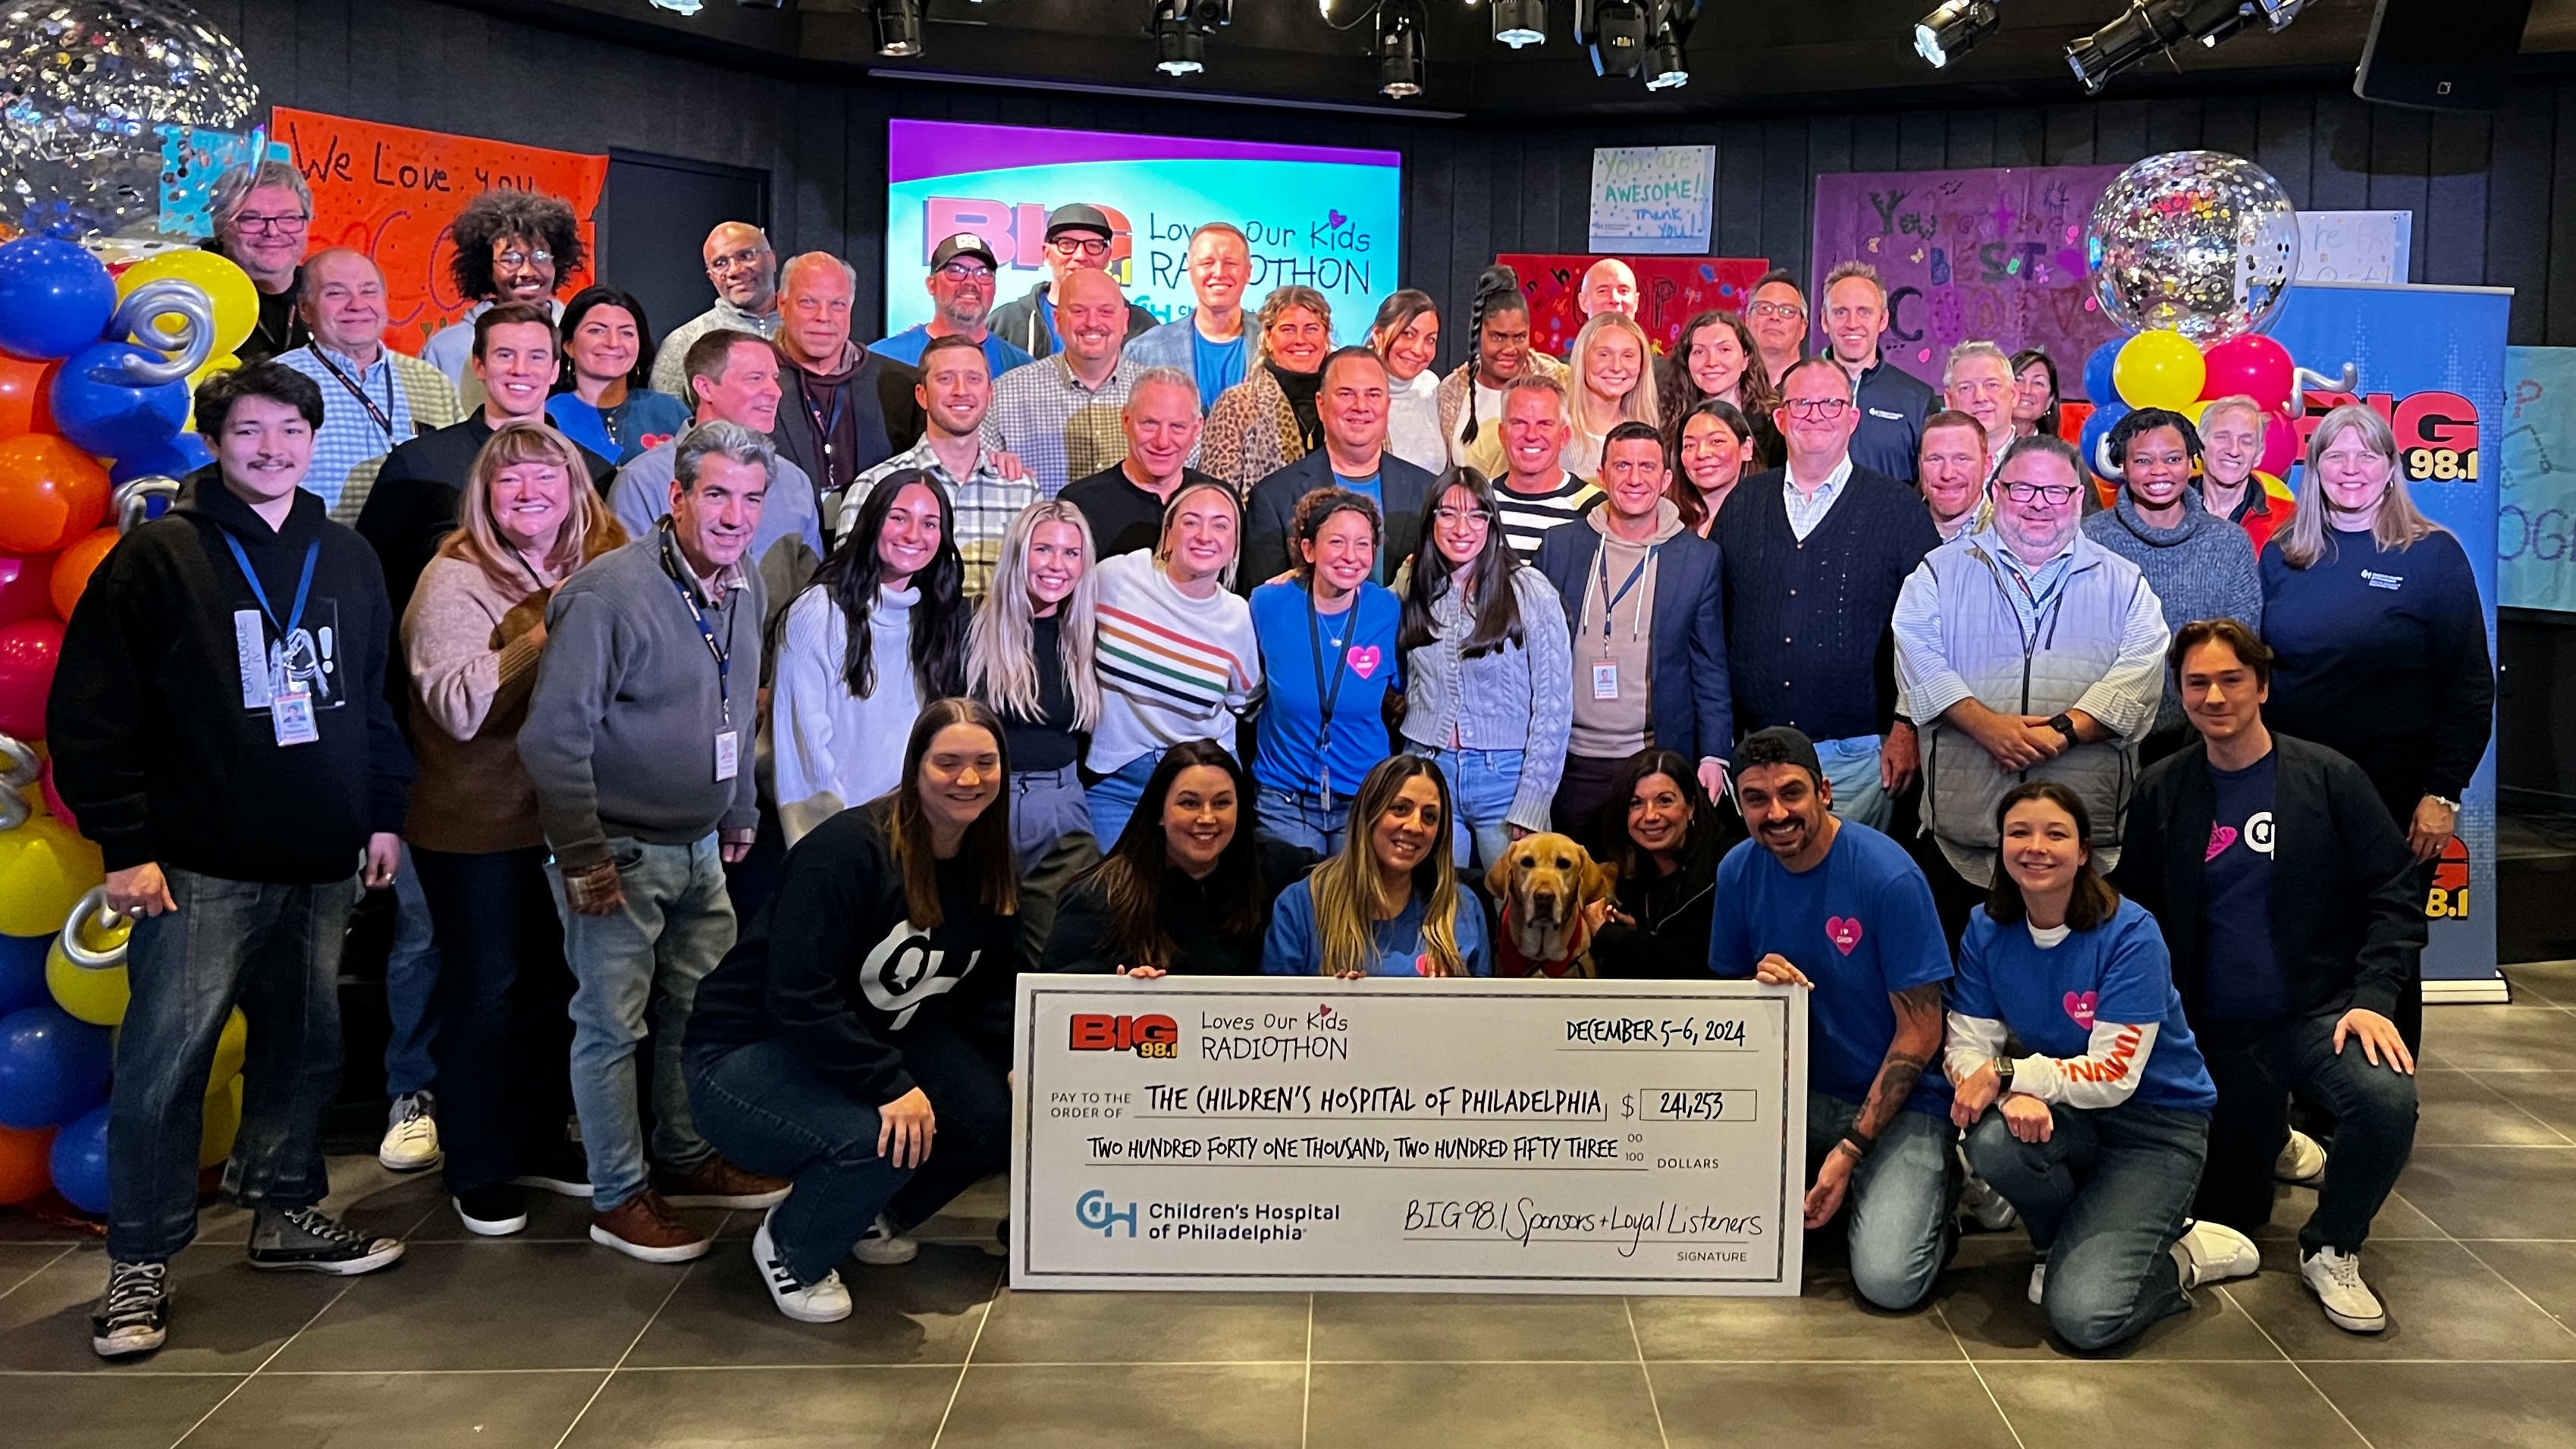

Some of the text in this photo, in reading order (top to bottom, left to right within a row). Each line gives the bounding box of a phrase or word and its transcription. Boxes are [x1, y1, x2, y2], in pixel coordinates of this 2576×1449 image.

[290, 121, 353, 183] We
[372, 141, 450, 192] Love
[1600, 150, 1643, 183] You
[1150, 212, 1370, 252] Lov Our Kids
[1150, 251, 1370, 295] RAOTHON
[2410, 449, 2477, 480] 98.1
[238, 622, 254, 695] CATALOGUE
[2424, 887, 2468, 918] 8.1
[1069, 1014, 1178, 1052] BIG
[1202, 1011, 1348, 1031] Loves Our Kids
[1567, 1017, 1746, 1047] DECEMBER 5-6, 2024
[1138, 1041, 1178, 1059] 98.1
[1202, 1036, 1348, 1062] RADIOTHON
[1052, 1092, 1131, 1104] PAY TO THE
[1144, 1085, 1602, 1116] THE CHILDREN'S HOSPITAL OF PHILADELPHIA
[1621, 1092, 1724, 1120] $ 241,253
[1051, 1108, 1122, 1118] ORDER OF
[1087, 1137, 1618, 1162] TWO HUNDRED FORTY ONE THOUSAND, TWO HUNDRED FIFTY THREE
[1627, 1133, 1643, 1143] 00
[1625, 1152, 1644, 1162] 100
[1657, 1158, 1719, 1169] DOLLARS
[1149, 1203, 1340, 1224] Children's Hospital
[1668, 1203, 1763, 1235] Listeners
[1149, 1223, 1303, 1244] of Philadelphia
[1677, 1251, 1747, 1262] SIGNATURE
